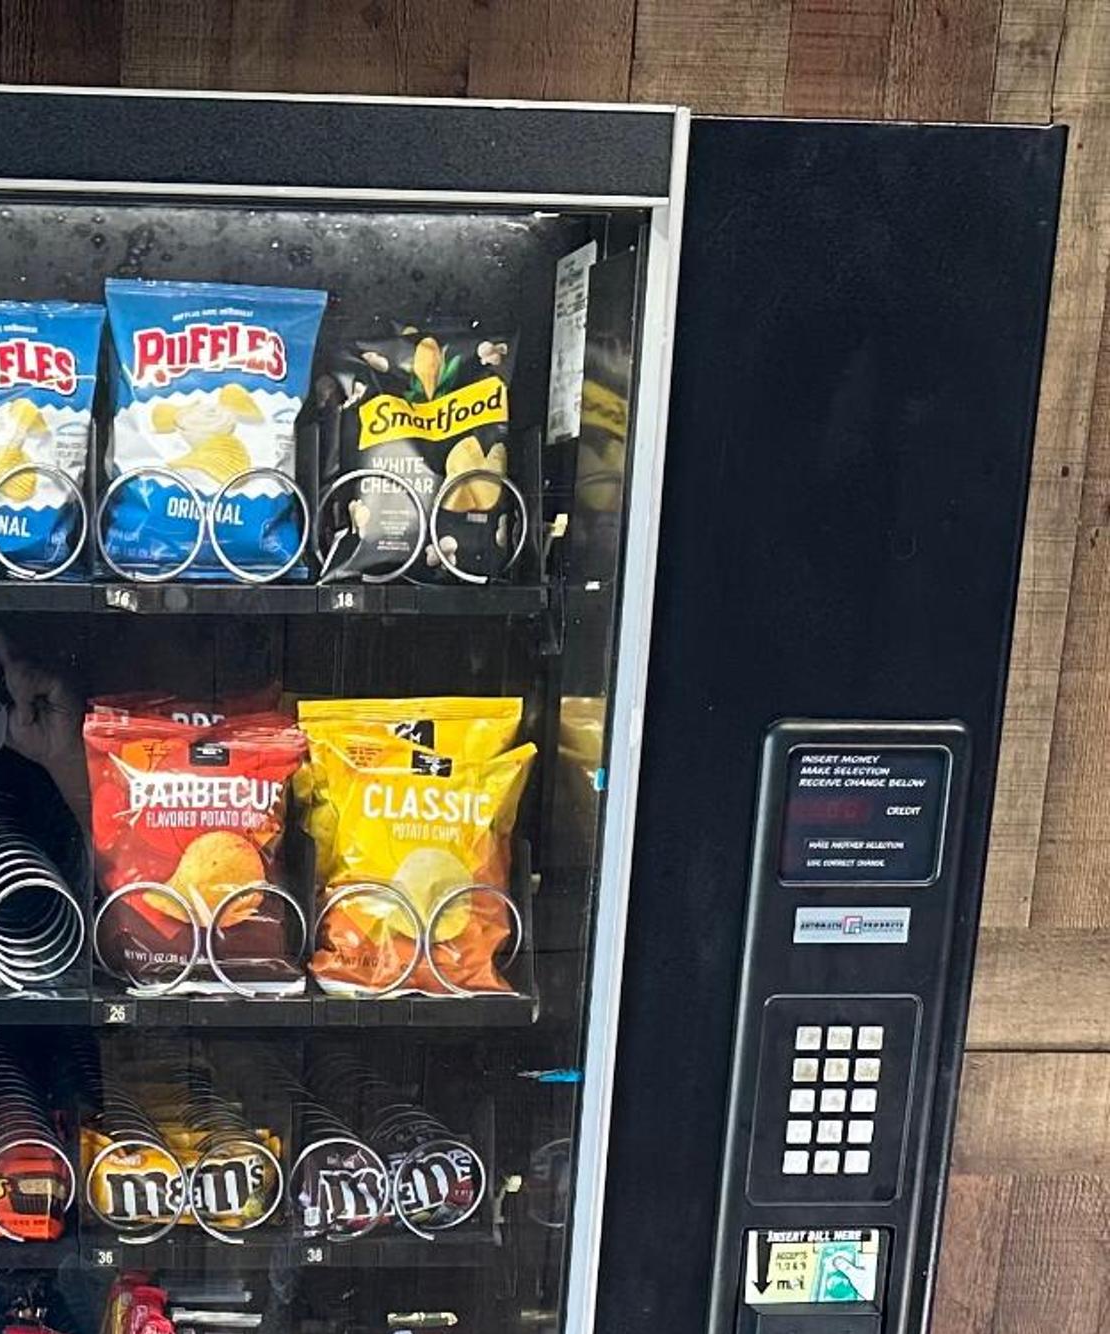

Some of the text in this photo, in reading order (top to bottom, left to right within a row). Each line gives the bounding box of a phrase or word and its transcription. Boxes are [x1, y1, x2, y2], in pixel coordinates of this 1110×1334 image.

[133, 323, 288, 386] RUFFLES
[369, 386, 503, 435] Smartfood
[372, 455, 425, 474] WHITE
[360, 478, 434, 496] CHEDAR
[166, 496, 245, 526] ORIGNAL
[114, 590, 131, 607] 16
[337, 593, 354, 607] 18
[801, 755, 880, 764] INSERT MONEY
[800, 766, 890, 776] MAKE SELECTION
[798, 778, 926, 788] RECEIVE CHANGE BELOW
[363, 783, 492, 826] CLASSIC
[886, 806, 922, 816] CREDIT
[146, 810, 197, 828] FLAVORED
[200, 810, 240, 828] POTATO
[392, 822, 430, 840] POTATO
[109, 1005, 126, 1021] 26
[767, 1230, 862, 1243] INSERT BILL HERE
[98, 1251, 114, 1265] 36
[307, 1248, 323, 1262] 38
[776, 1251, 808, 1260] ACCEPTS
